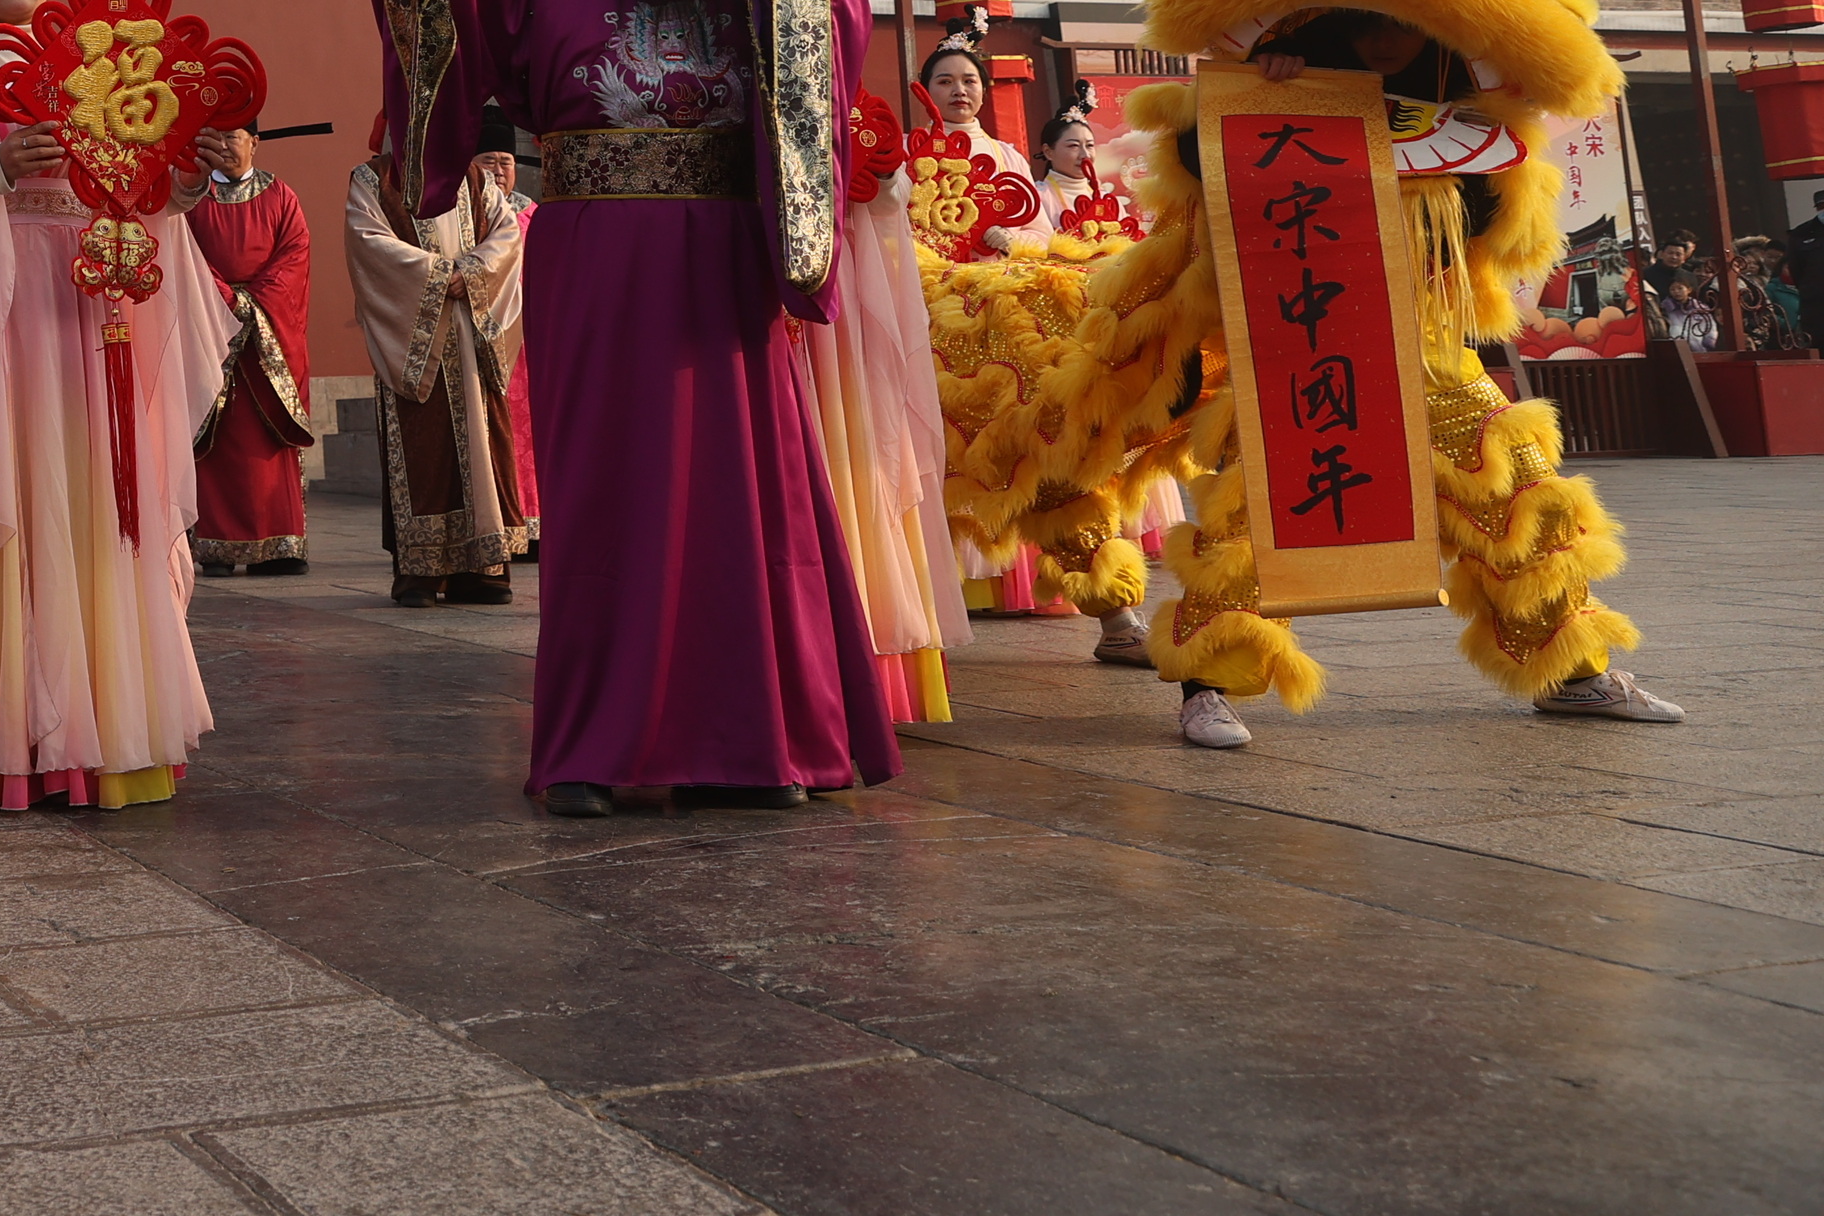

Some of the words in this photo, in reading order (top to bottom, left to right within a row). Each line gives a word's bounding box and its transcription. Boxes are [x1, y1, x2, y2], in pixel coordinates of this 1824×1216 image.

[62, 18, 180, 146] 福
[908, 156, 979, 235] 福
[1252, 123, 1373, 534] 大宋中國年
